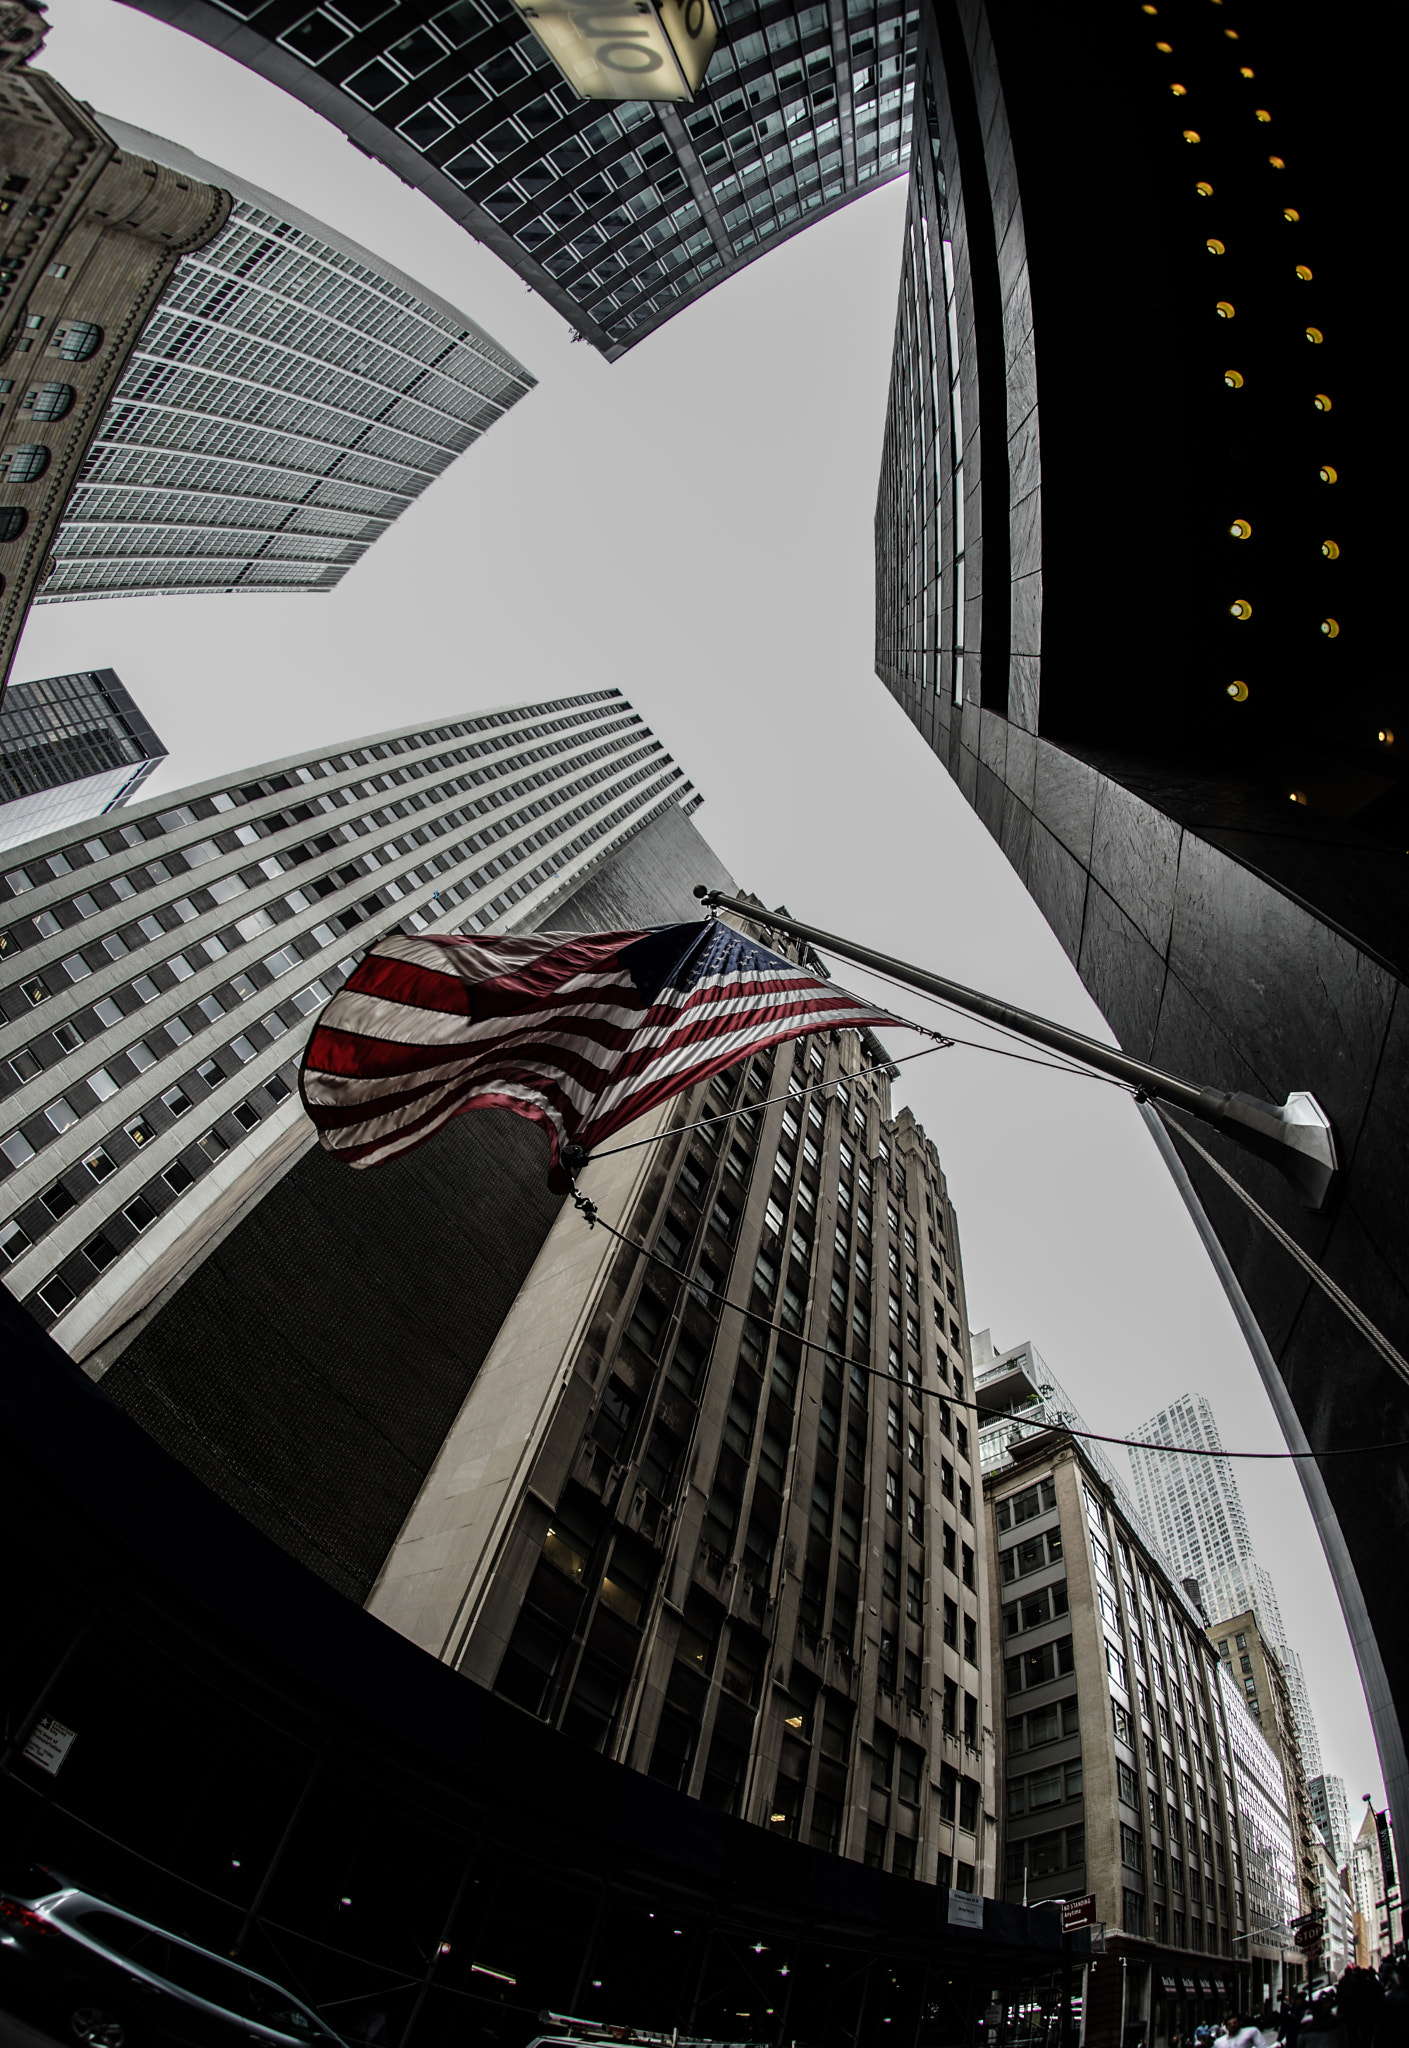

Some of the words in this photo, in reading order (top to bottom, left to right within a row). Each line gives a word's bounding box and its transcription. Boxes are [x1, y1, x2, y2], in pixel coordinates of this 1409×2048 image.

[563, 0, 664, 73] on
[32, 1731, 62, 1753] Transportation
[43, 1732, 53, 1742] Dept
[1070, 1897, 1091, 1910] STANDING
[1064, 1909, 1082, 1918] Anytime
[1296, 1926, 1322, 1943] STOP
